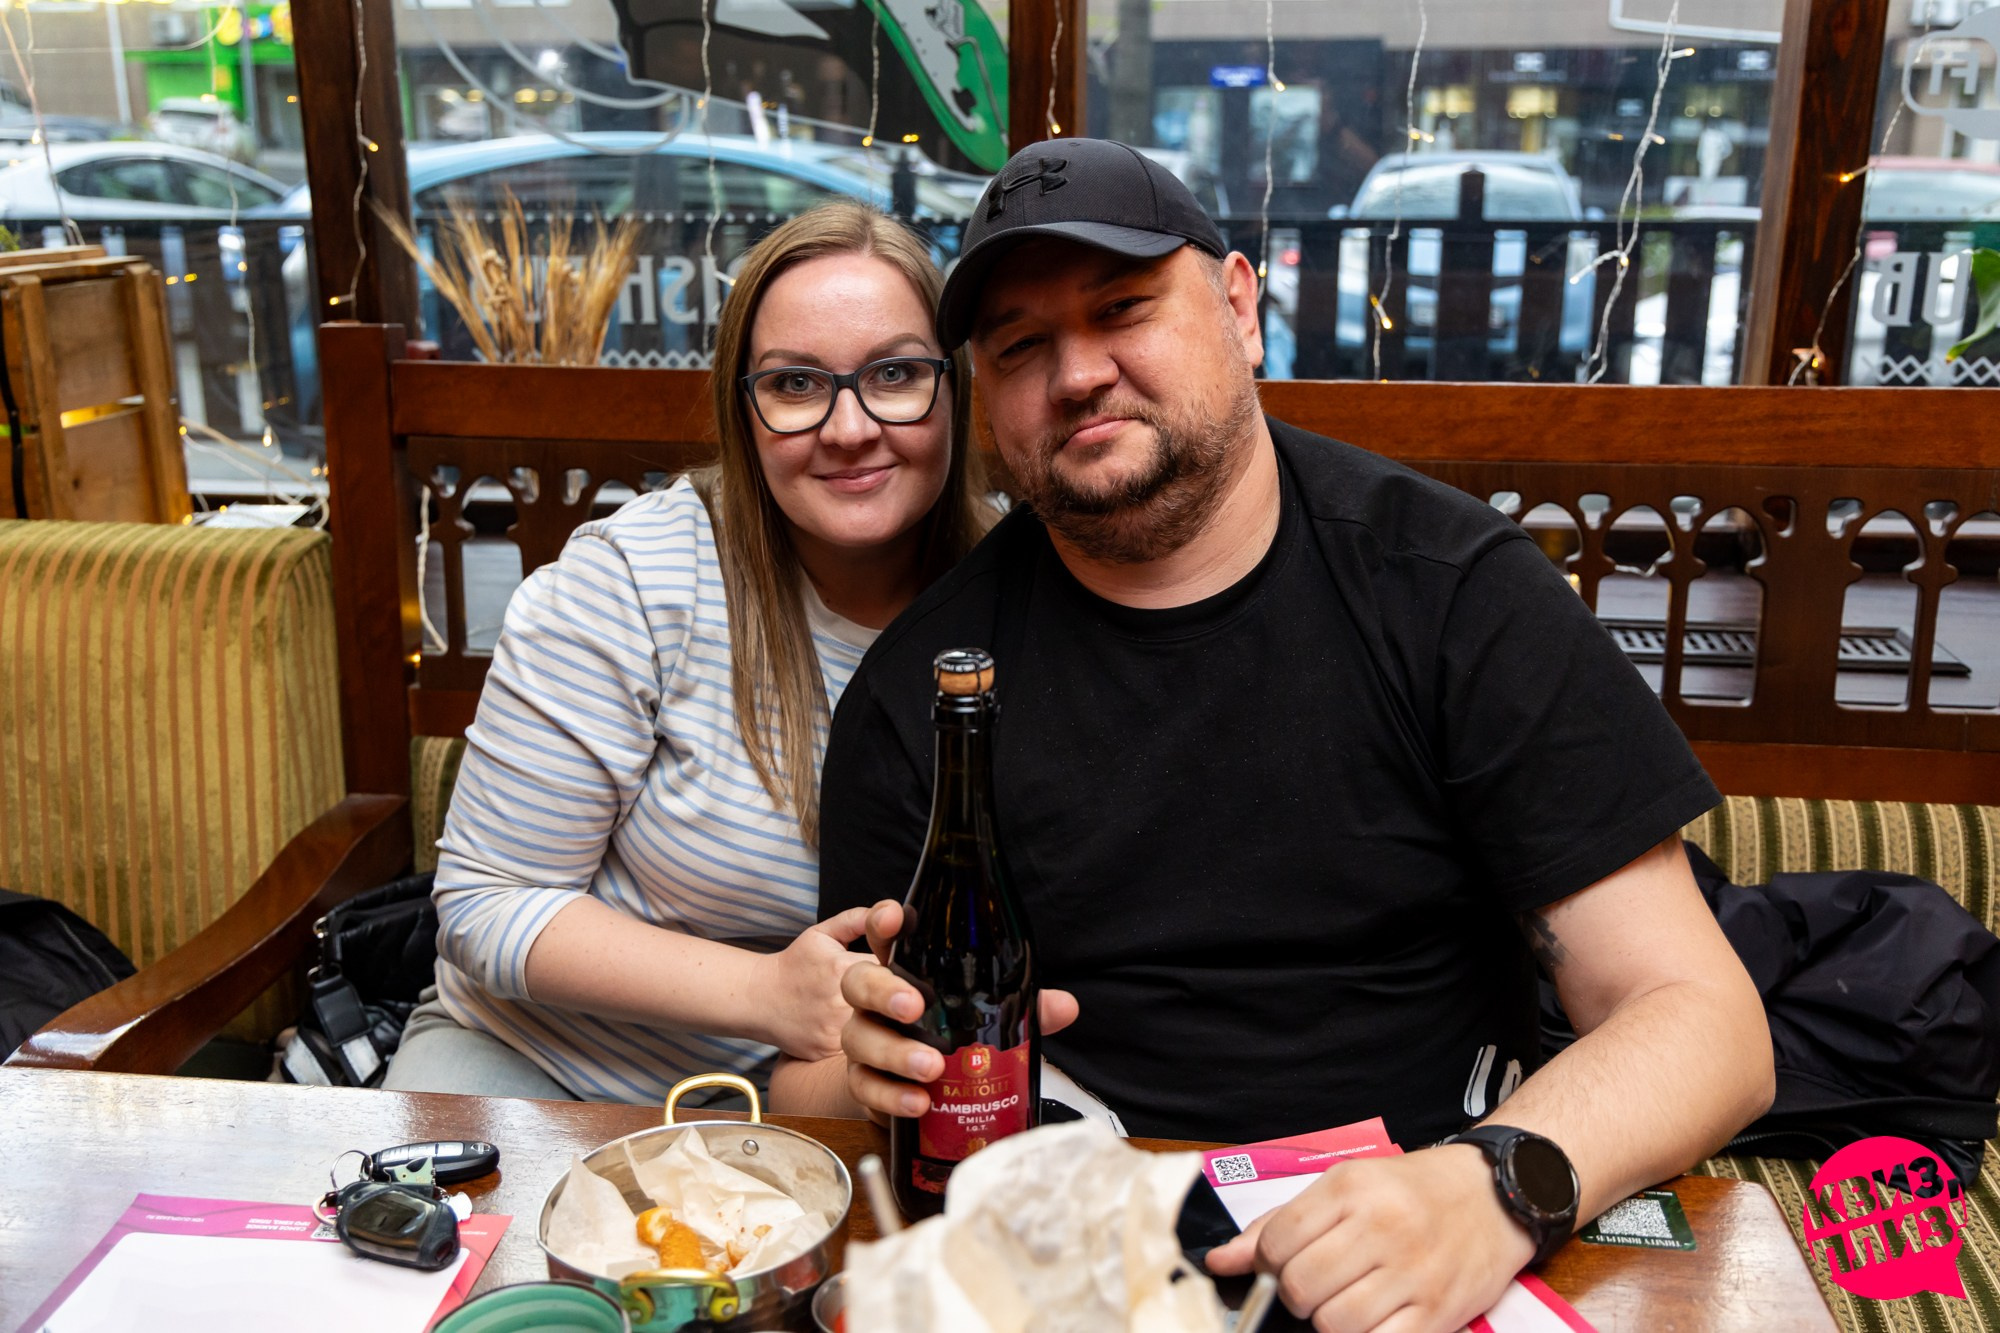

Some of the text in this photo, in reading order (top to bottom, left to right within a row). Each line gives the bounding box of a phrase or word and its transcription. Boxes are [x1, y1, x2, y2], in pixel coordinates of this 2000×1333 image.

[971, 1054, 982, 1066] B
[931, 1094, 1019, 1114] LAMBRUSCO
[957, 1114, 996, 1124] EMILIA
[1595, 1234, 1682, 1248] TRINITY IRISH PUB
